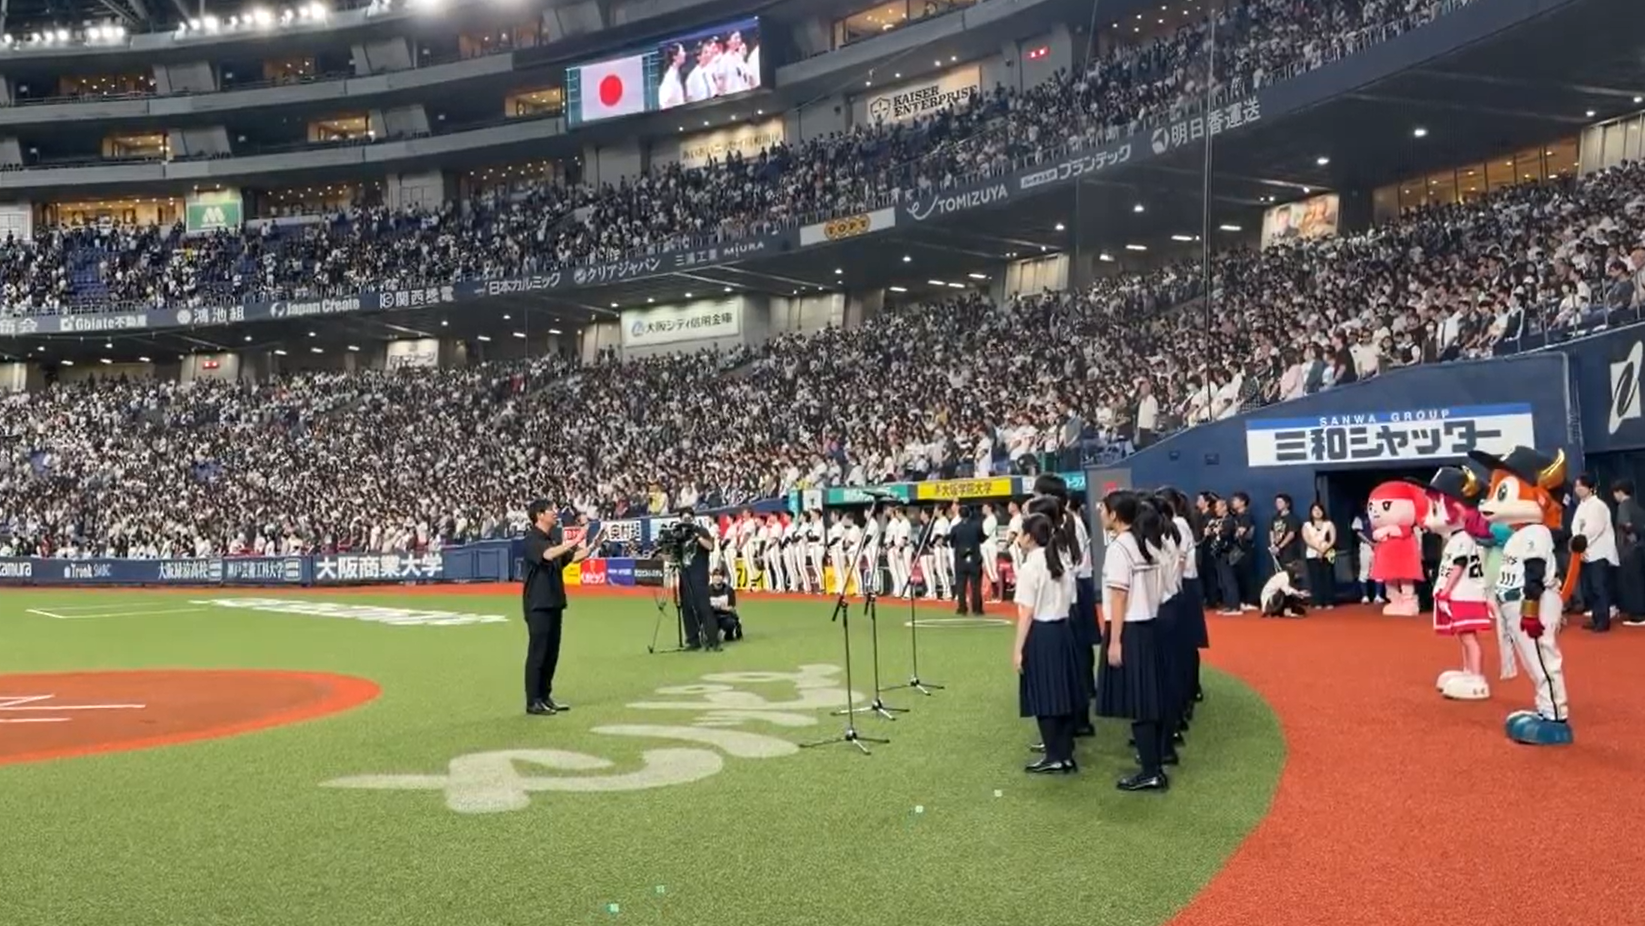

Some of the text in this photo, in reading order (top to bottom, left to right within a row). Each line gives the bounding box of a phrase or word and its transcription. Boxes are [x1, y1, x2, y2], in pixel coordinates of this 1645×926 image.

[893, 86, 939, 106] KAISER
[894, 85, 978, 117] ENTERPRISE
[1171, 96, 1261, 147] 明日香運送
[1058, 144, 1131, 180] プランテック
[937, 184, 1009, 214] TOMIZUYA
[587, 258, 661, 283] クリアジャパン
[489, 272, 561, 296] 日本カルミック
[194, 306, 244, 324] 鴻池組
[286, 297, 360, 316] Japan Create
[646, 312, 733, 334] 大阪シティ信用金庫
[1319, 409, 1450, 428] SANWA GROUP
[1275, 420, 1501, 461] 三和シャッター
[316, 553, 443, 579] 大阪商業大学
